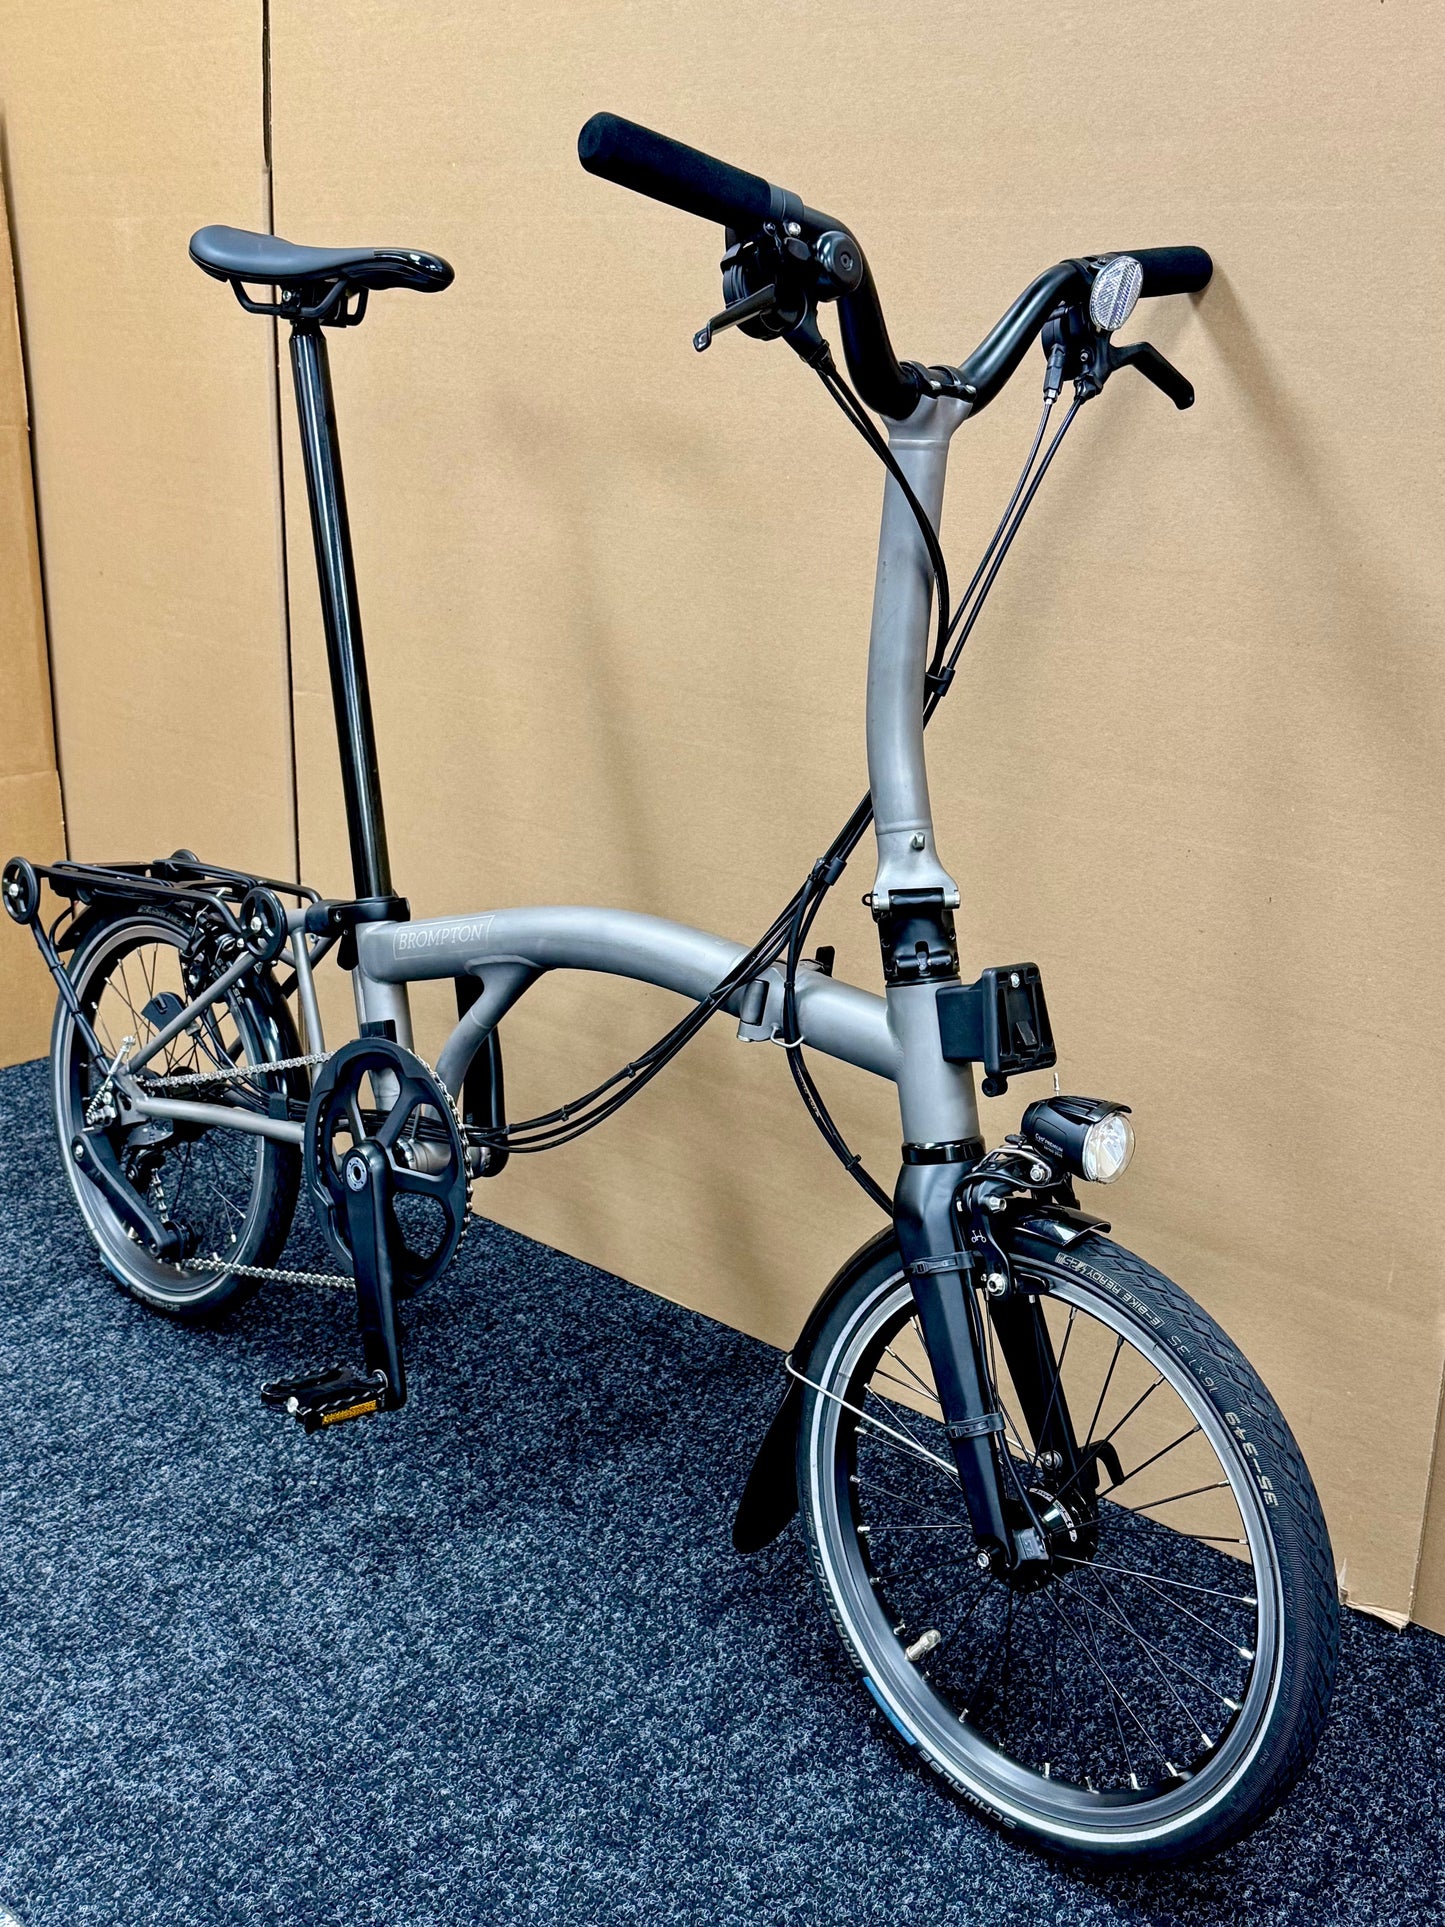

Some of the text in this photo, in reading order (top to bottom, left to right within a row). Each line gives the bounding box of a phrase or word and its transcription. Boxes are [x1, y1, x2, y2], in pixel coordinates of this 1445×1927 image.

[399, 924, 483, 950] BROMPTON
[1086, 1268, 1122, 1294] READY
[1122, 1291, 1162, 1328] E-BIKE
[1224, 1411, 1279, 1508] 35-349
[811, 1543, 863, 1670] MARATHON
[918, 1749, 1019, 1830] SCHWALBE
